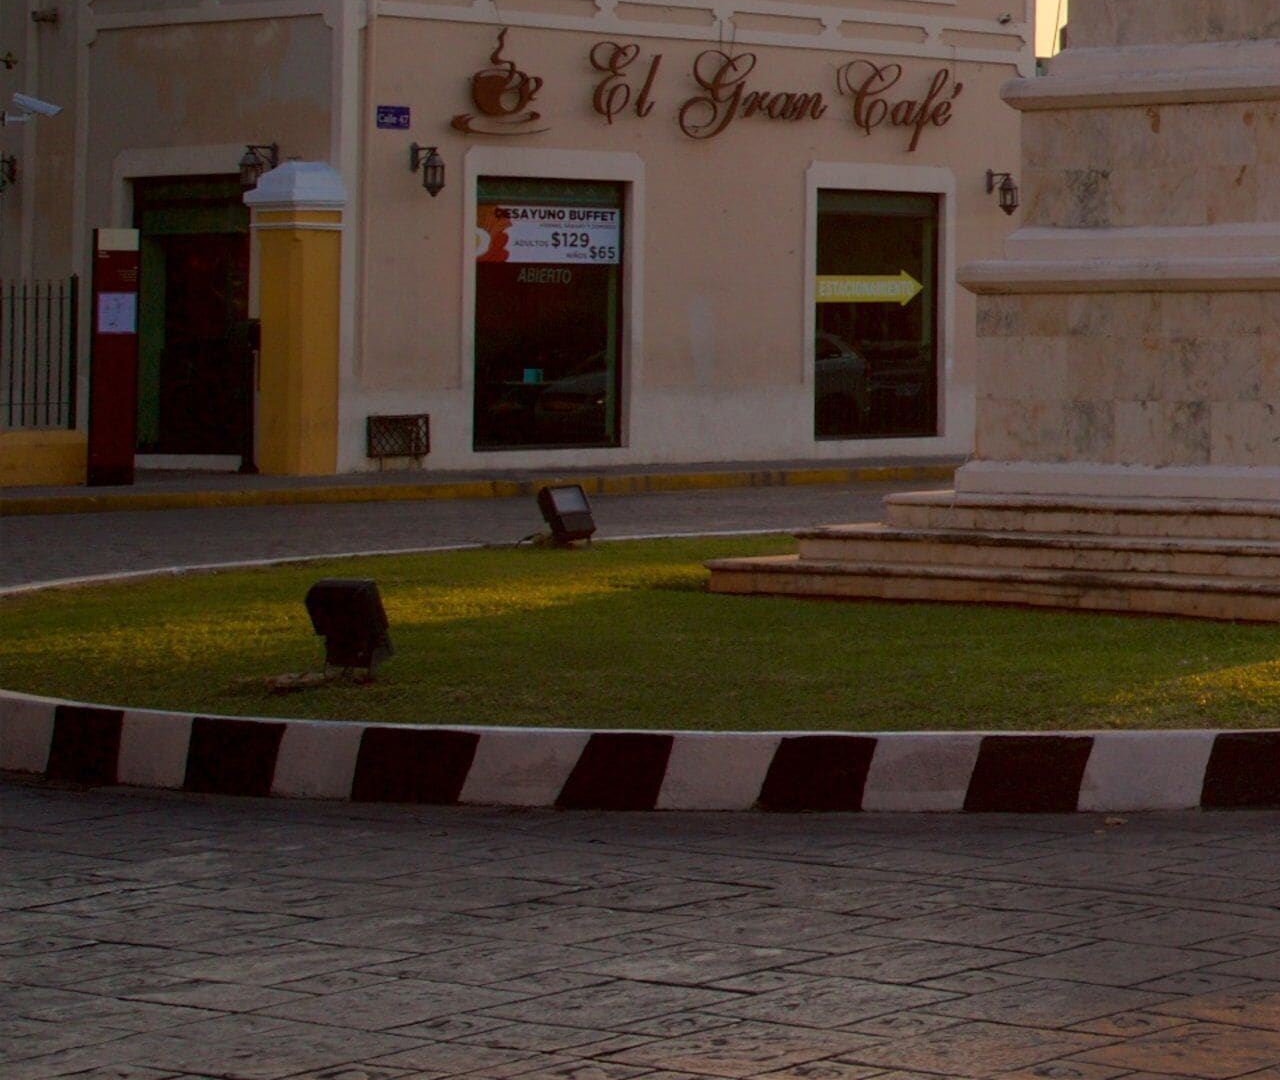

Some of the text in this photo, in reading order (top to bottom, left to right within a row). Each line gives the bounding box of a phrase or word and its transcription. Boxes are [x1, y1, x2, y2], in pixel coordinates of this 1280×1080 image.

[590, 42, 963, 151] El Gran Café
[378, 113, 410, 124] Calle 47
[495, 208, 616, 222] DESAYUNO BUFFET
[514, 231, 590, 248] ADULTOS $129
[589, 245, 616, 260] $65
[518, 268, 572, 284] ABIERTO
[819, 280, 914, 296] ESTACIONAMIENTO
